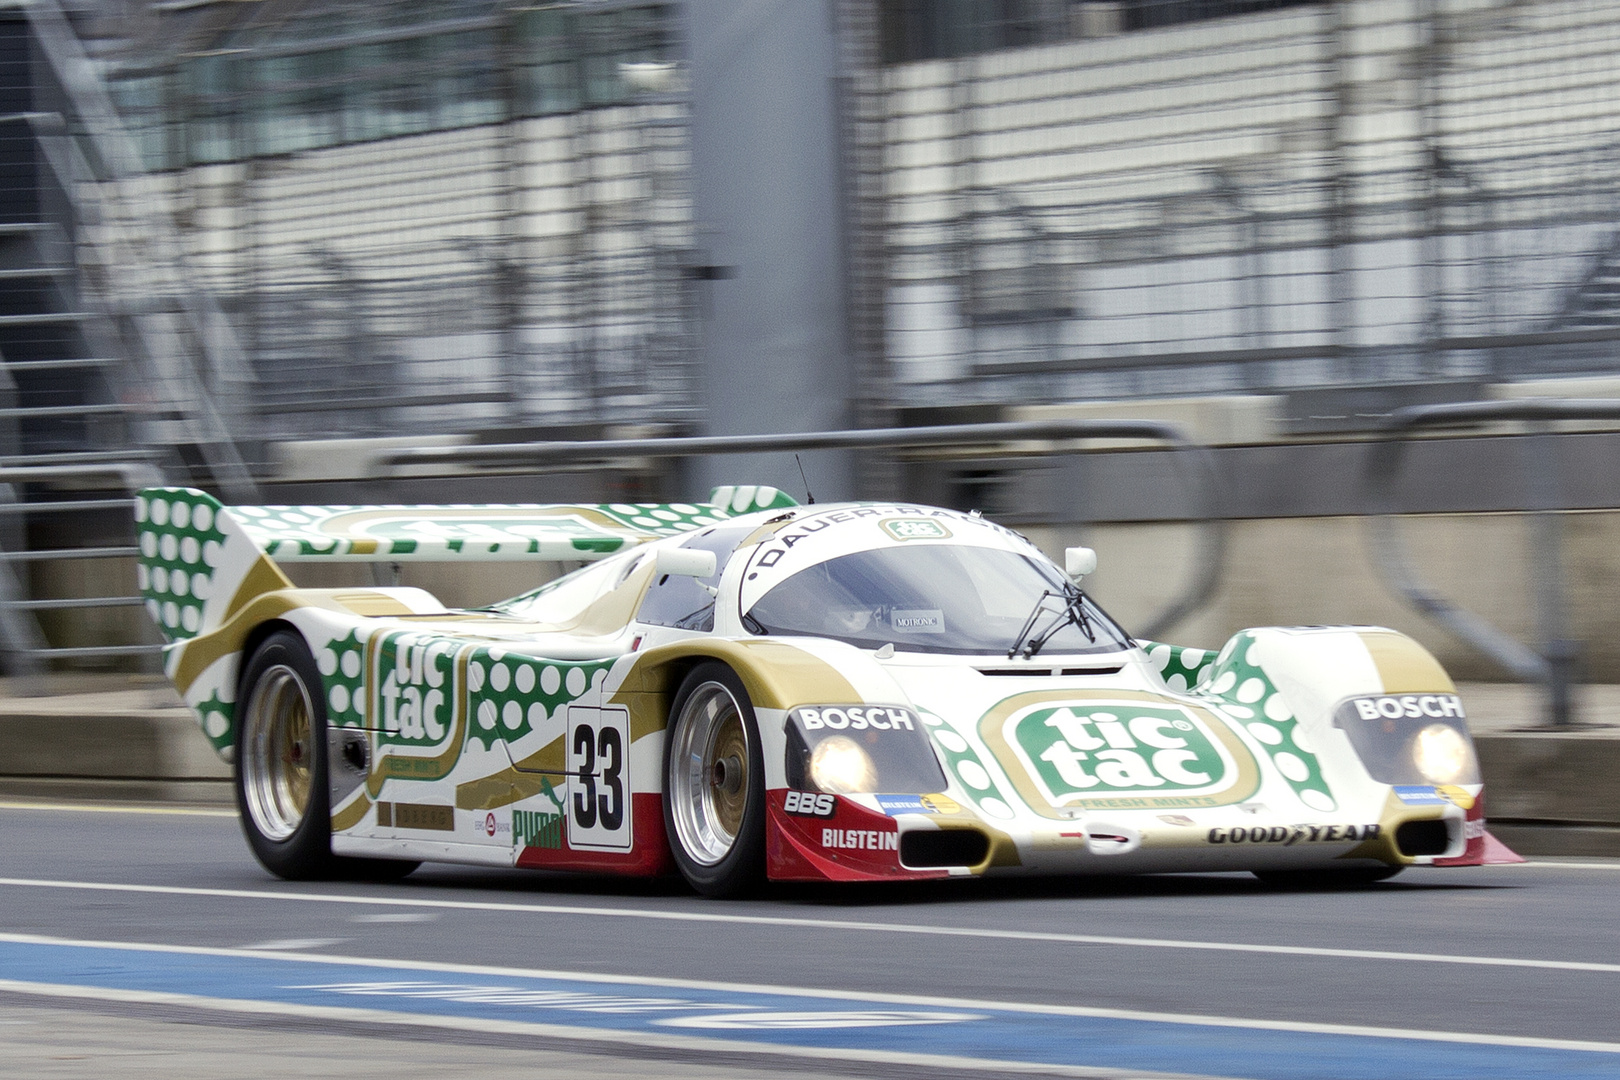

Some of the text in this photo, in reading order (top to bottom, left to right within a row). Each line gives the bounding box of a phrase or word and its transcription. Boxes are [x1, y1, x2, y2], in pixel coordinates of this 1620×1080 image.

[896, 617, 937, 627] MOTRONIC
[394, 634, 445, 688] tic
[381, 669, 445, 741] tac
[1354, 696, 1466, 720] BOSCH
[798, 707, 914, 730] BOSCH
[1044, 707, 1190, 750] tic
[1039, 740, 1212, 788] tac
[573, 723, 623, 831] 33
[783, 791, 835, 816] BBS
[880, 801, 922, 809] BILSTEIN
[1079, 797, 1218, 807] FRESH MINTS
[512, 809, 562, 850] PUMA
[822, 828, 898, 851] BILSTEIN
[1207, 823, 1382, 846] GOODYEAR
